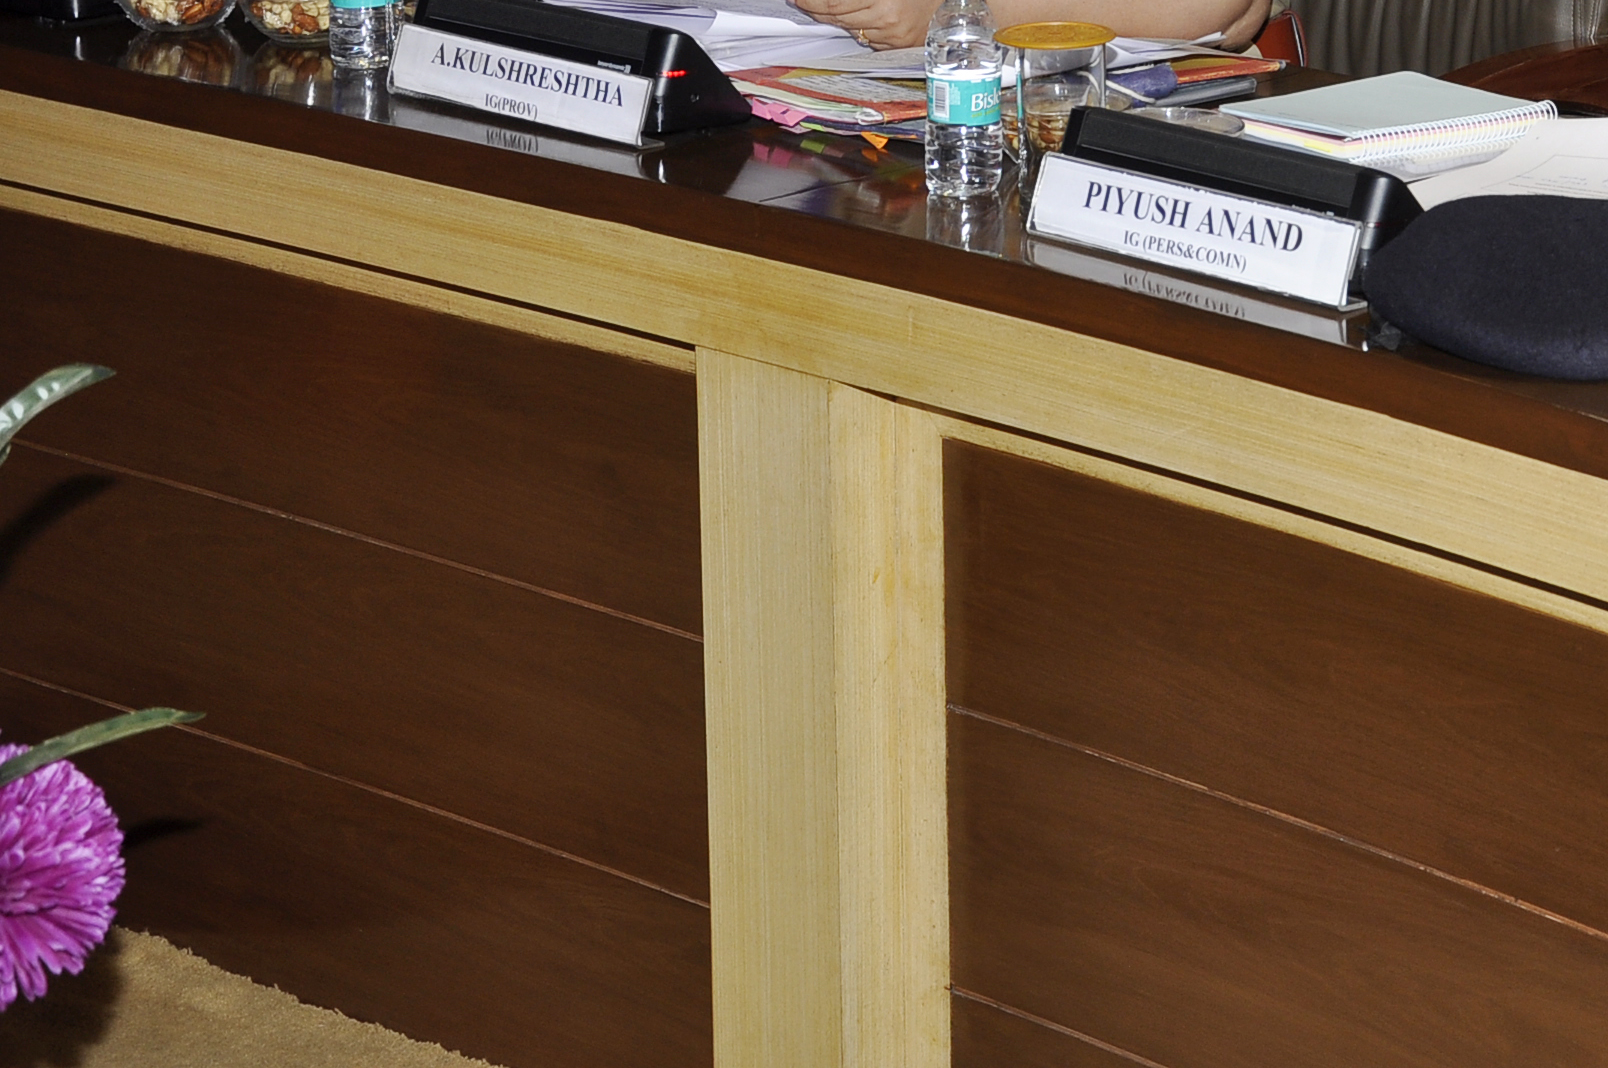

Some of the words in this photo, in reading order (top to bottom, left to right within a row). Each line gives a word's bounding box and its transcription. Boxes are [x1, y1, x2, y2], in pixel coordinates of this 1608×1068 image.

[430, 42, 623, 108] A.KULSHRESHTHA
[485, 93, 538, 120] IG(PROV)
[971, 86, 1001, 112] Bisl
[1083, 180, 1192, 229] PIYUSH
[1195, 205, 1304, 252] ANAND
[1123, 230, 1140, 246] IG
[1142, 234, 1247, 273] (PERS&COMN)
